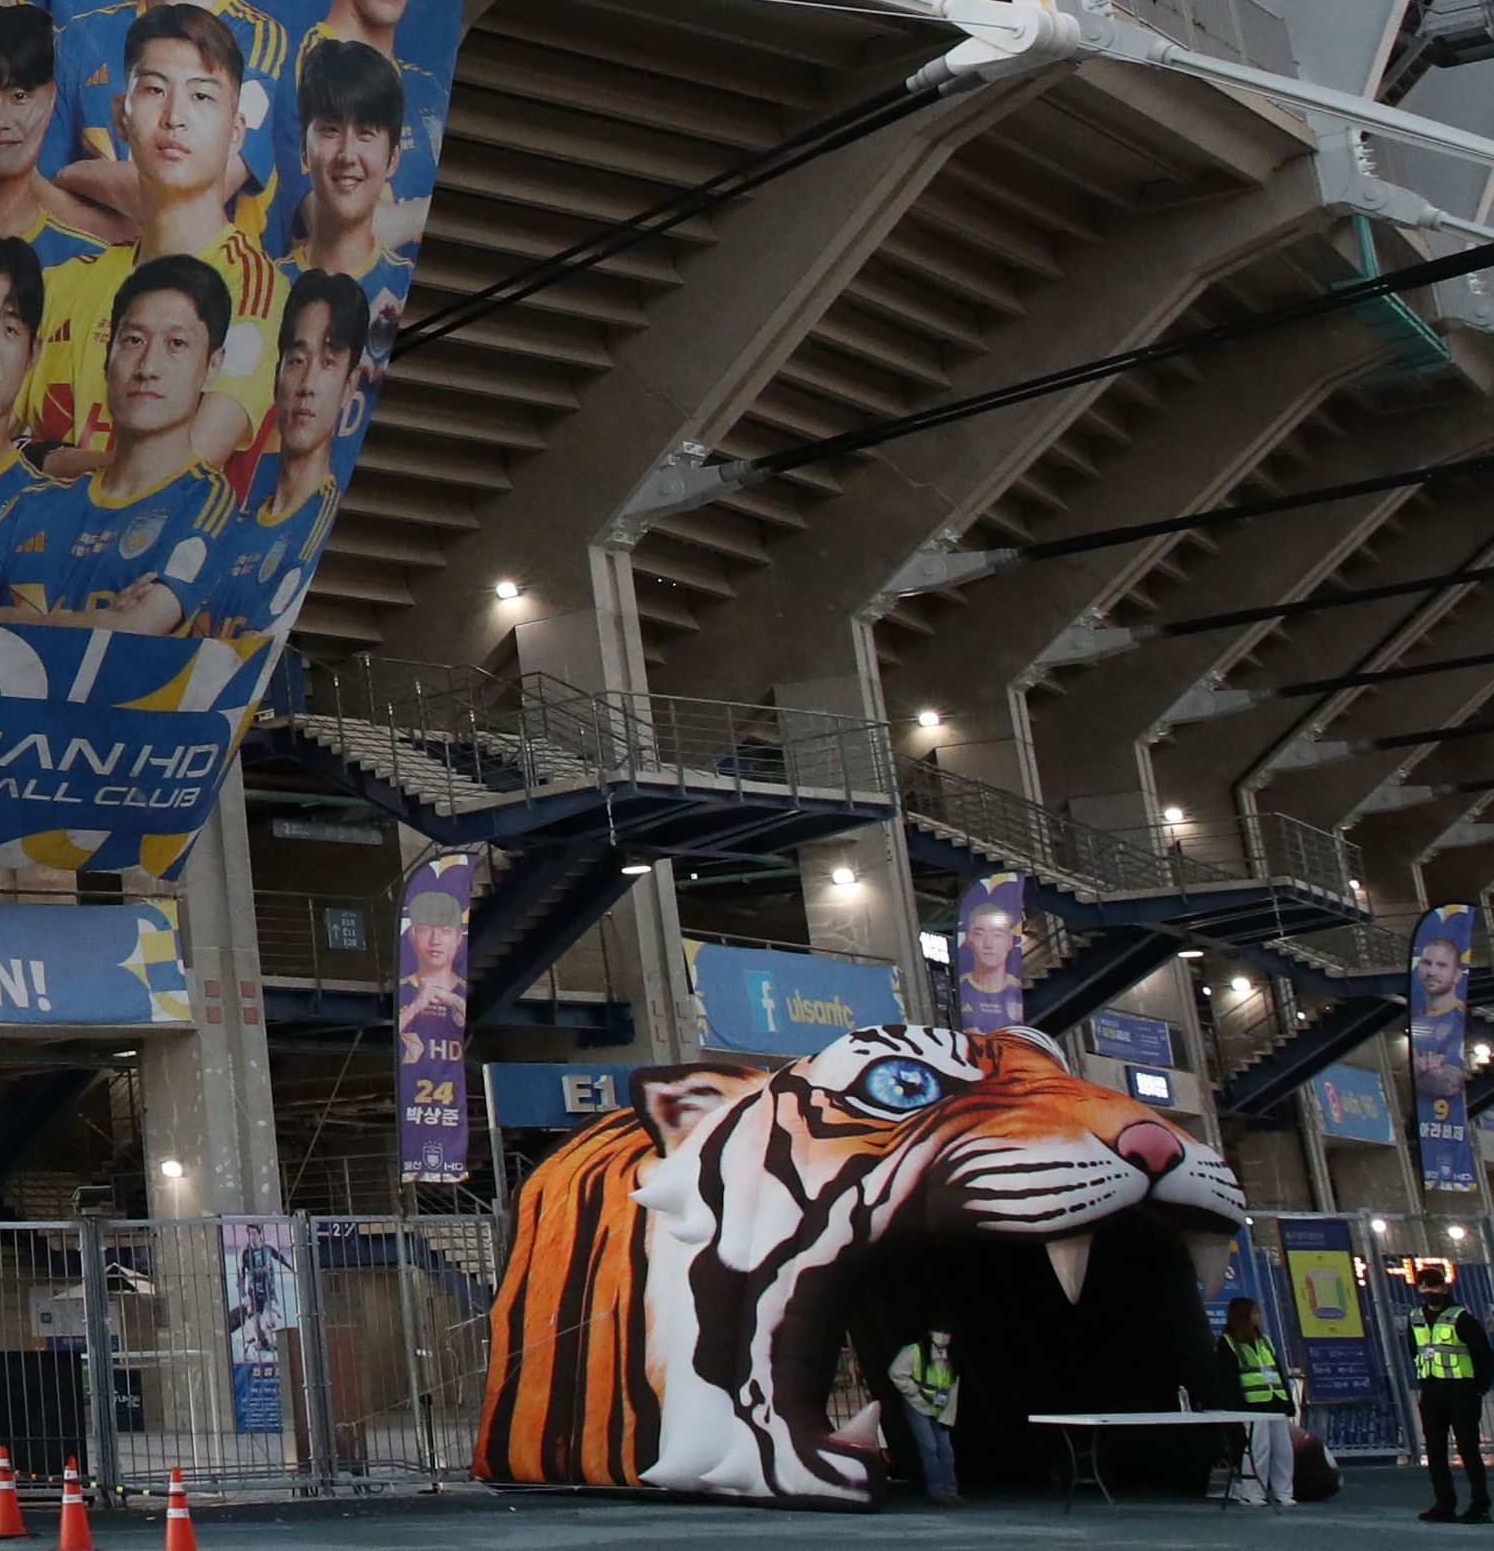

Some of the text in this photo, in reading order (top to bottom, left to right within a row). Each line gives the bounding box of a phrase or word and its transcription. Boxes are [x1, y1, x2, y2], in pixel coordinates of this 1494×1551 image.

[129, 744, 219, 780] HD
[93, 786, 201, 809] CLUB
[787, 995, 854, 1028] ulsanfc
[428, 1039, 463, 1061] HD
[414, 1079, 454, 1105] 24
[562, 1073, 620, 1114] E1
[406, 1107, 459, 1126] 박상준
[1433, 1099, 1449, 1121] 9
[444, 1162, 463, 1171] HD
